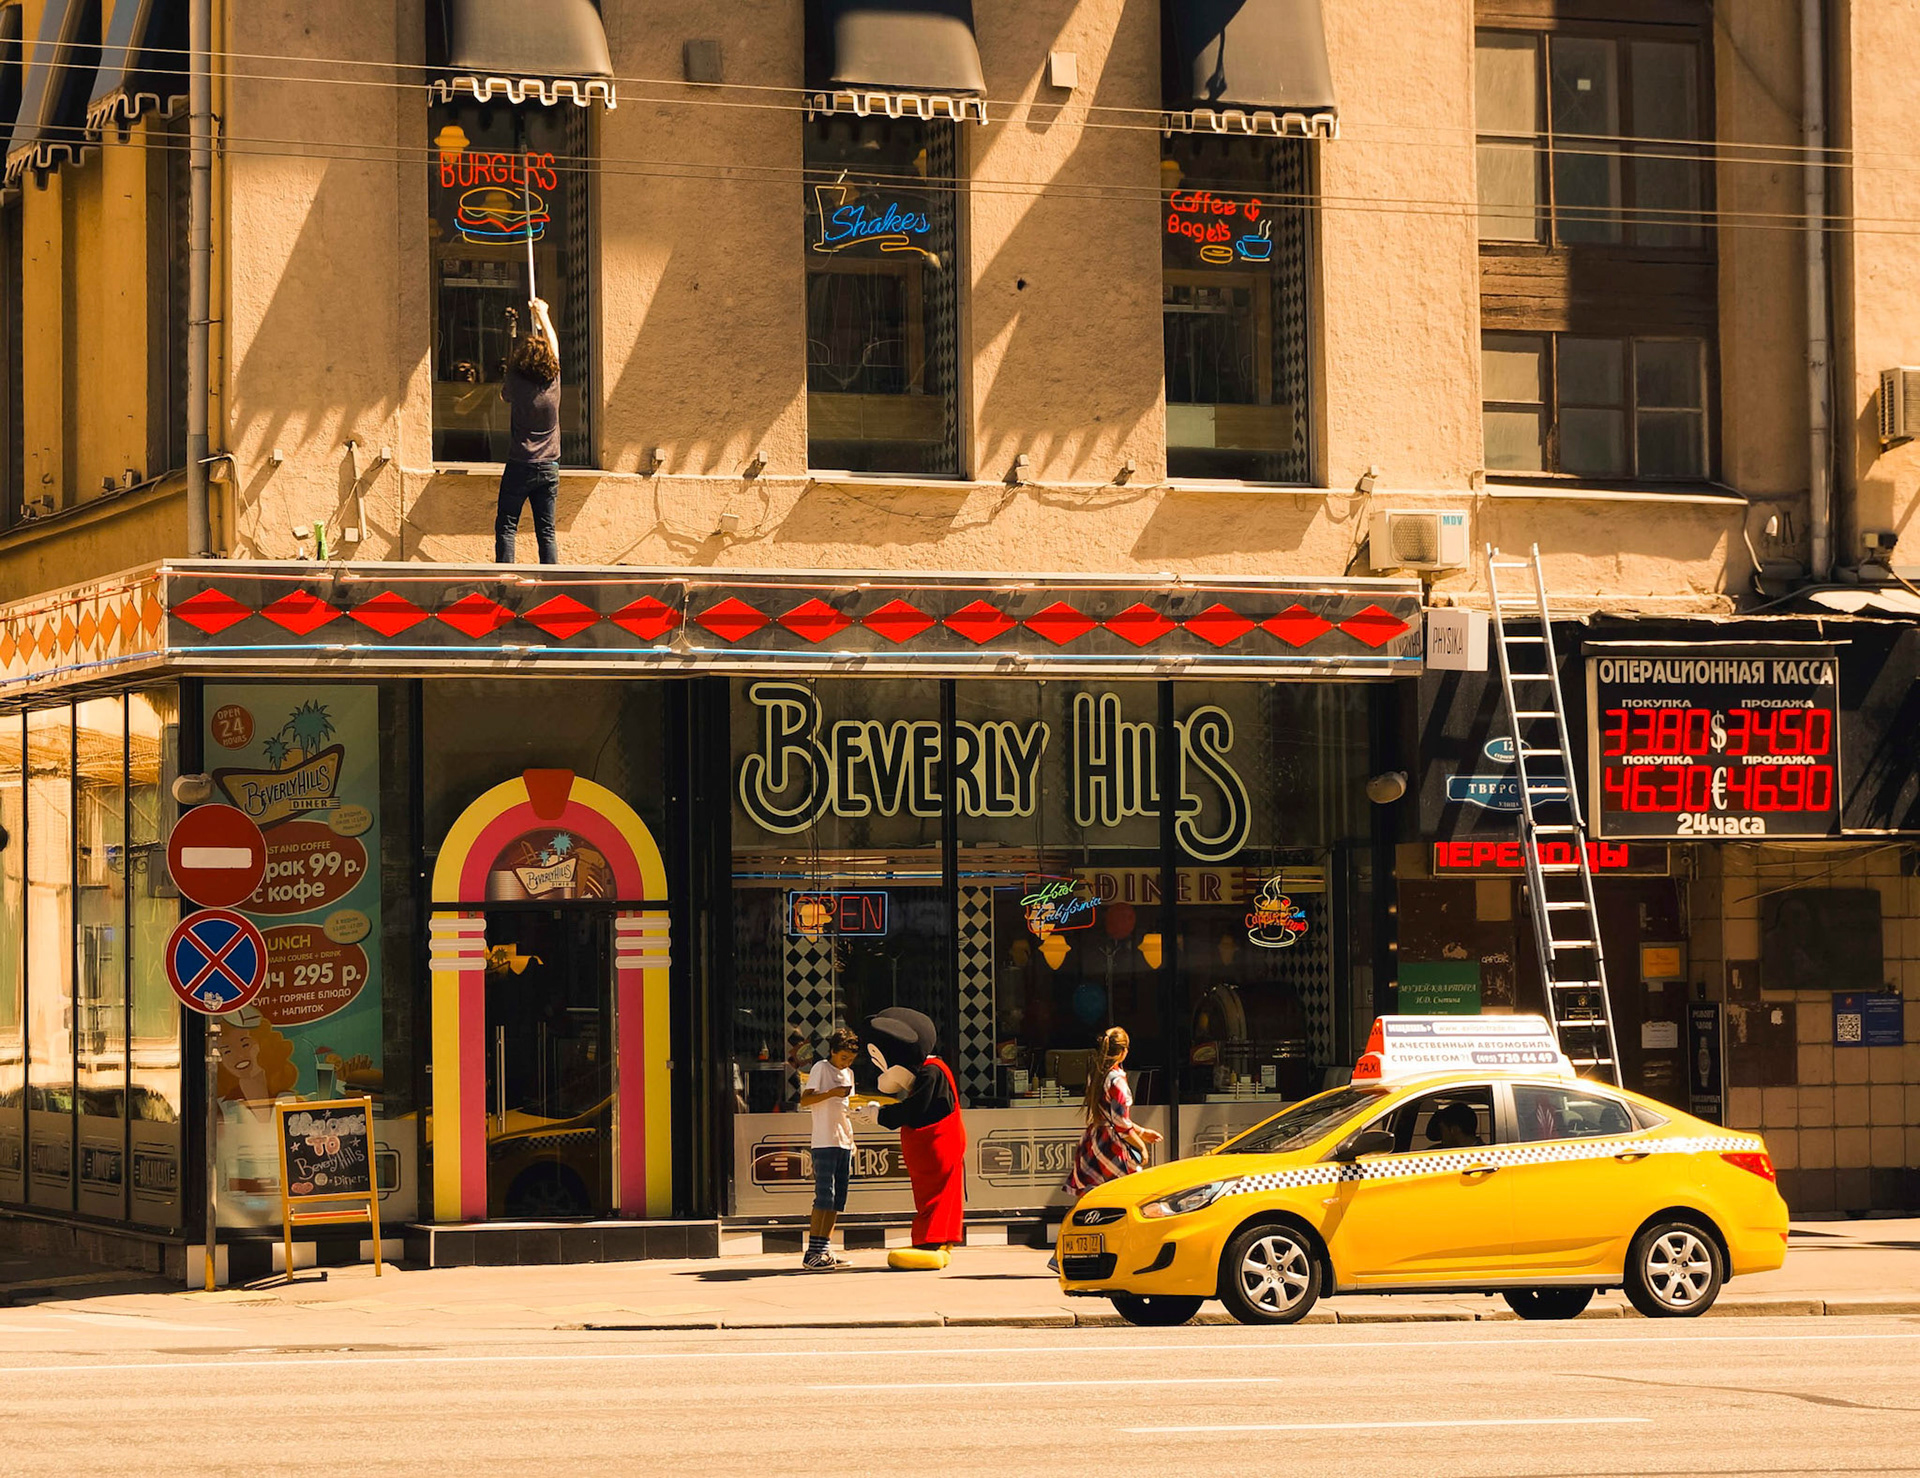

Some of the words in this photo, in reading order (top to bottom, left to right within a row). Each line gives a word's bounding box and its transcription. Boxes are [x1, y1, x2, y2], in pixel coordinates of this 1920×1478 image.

[1170, 190, 1237, 215] Coffee
[825, 202, 931, 240] Shakes
[1168, 213, 1231, 243] Bagels
[1443, 515, 1463, 526] MDV
[1432, 627, 1464, 655] PHYSIKA
[1599, 660, 1765, 685] ОПЕРАЦИОННАЯ
[1773, 660, 1834, 685] КАССА
[217, 707, 241, 720] OPEN
[1622, 699, 1692, 709] ПОКУПКА
[1741, 699, 1815, 709] ПРОДАЖА
[219, 717, 245, 737] 24
[1622, 755, 1694, 765] ПОКУПКА
[1742, 755, 1816, 765] ПРОДАЖА
[739, 682, 1050, 834] BEVERLY
[1073, 691, 1251, 862] HILLS
[241, 777, 298, 816] BEVERLY
[297, 765, 331, 796] HILLS
[293, 799, 328, 809] DINER
[280, 843, 299, 854] AND
[301, 840, 331, 852] COFFEE
[266, 859, 306, 883] рак
[309, 851, 341, 877] 99
[344, 859, 361, 877] р.
[268, 878, 325, 905] кофе
[1096, 873, 1222, 902] DINER
[793, 896, 882, 931] OPEN
[267, 934, 311, 951] UNCH
[287, 952, 313, 962] COURSE
[320, 950, 342, 959] DRINK
[294, 963, 334, 986] 295
[342, 965, 362, 987] р.
[280, 993, 316, 1003] ГОРЯЧЕЕ
[318, 988, 351, 999] БЛЮДО
[282, 1004, 324, 1016] НАПИТОК
[1391, 1040, 1475, 1049] КАЧЕСТВЕННЫЙ
[1478, 1040, 1551, 1049] АВТОМОБИЛЬ
[1391, 1055, 1397, 1063] С
[305, 1135, 340, 1157] TO
[800, 1148, 889, 1177] BERS
[1076, 1237, 1088, 1251] 173
